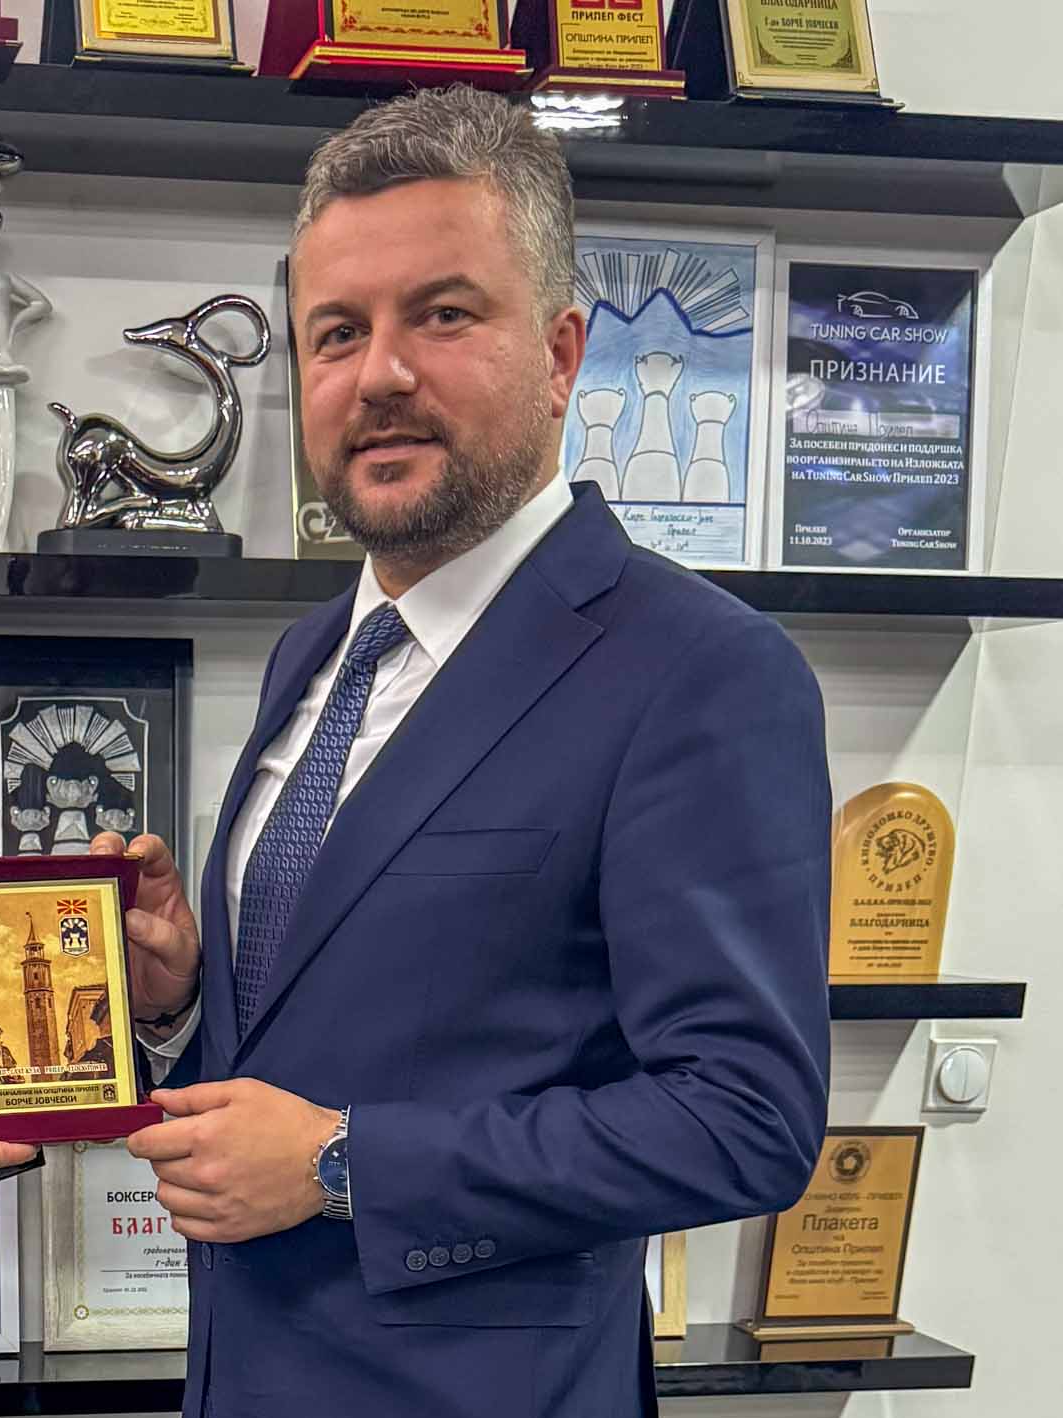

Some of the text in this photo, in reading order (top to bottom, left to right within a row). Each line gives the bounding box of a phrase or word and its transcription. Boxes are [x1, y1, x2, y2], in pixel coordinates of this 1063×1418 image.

[571, 10, 644, 22] ПРИЛЕП ФЕСТ
[565, 32, 654, 45] ОПШТИНА ПРИЛЕП
[810, 323, 948, 344] TUNING CAR SHOW
[809, 360, 946, 385] ПРИЗНАНИЕ
[933, 474, 960, 486] 2023
[849, 917, 930, 928] БЛАГОДАРНИЦА
[43, 1087, 75, 1095] ОПШТИНА
[5, 1095, 78, 1107] БОРЧЕ ЈОВЧЕСКИ
[106, 1191, 159, 1203] БОКСЕР
[802, 1213, 880, 1232] Плакета
